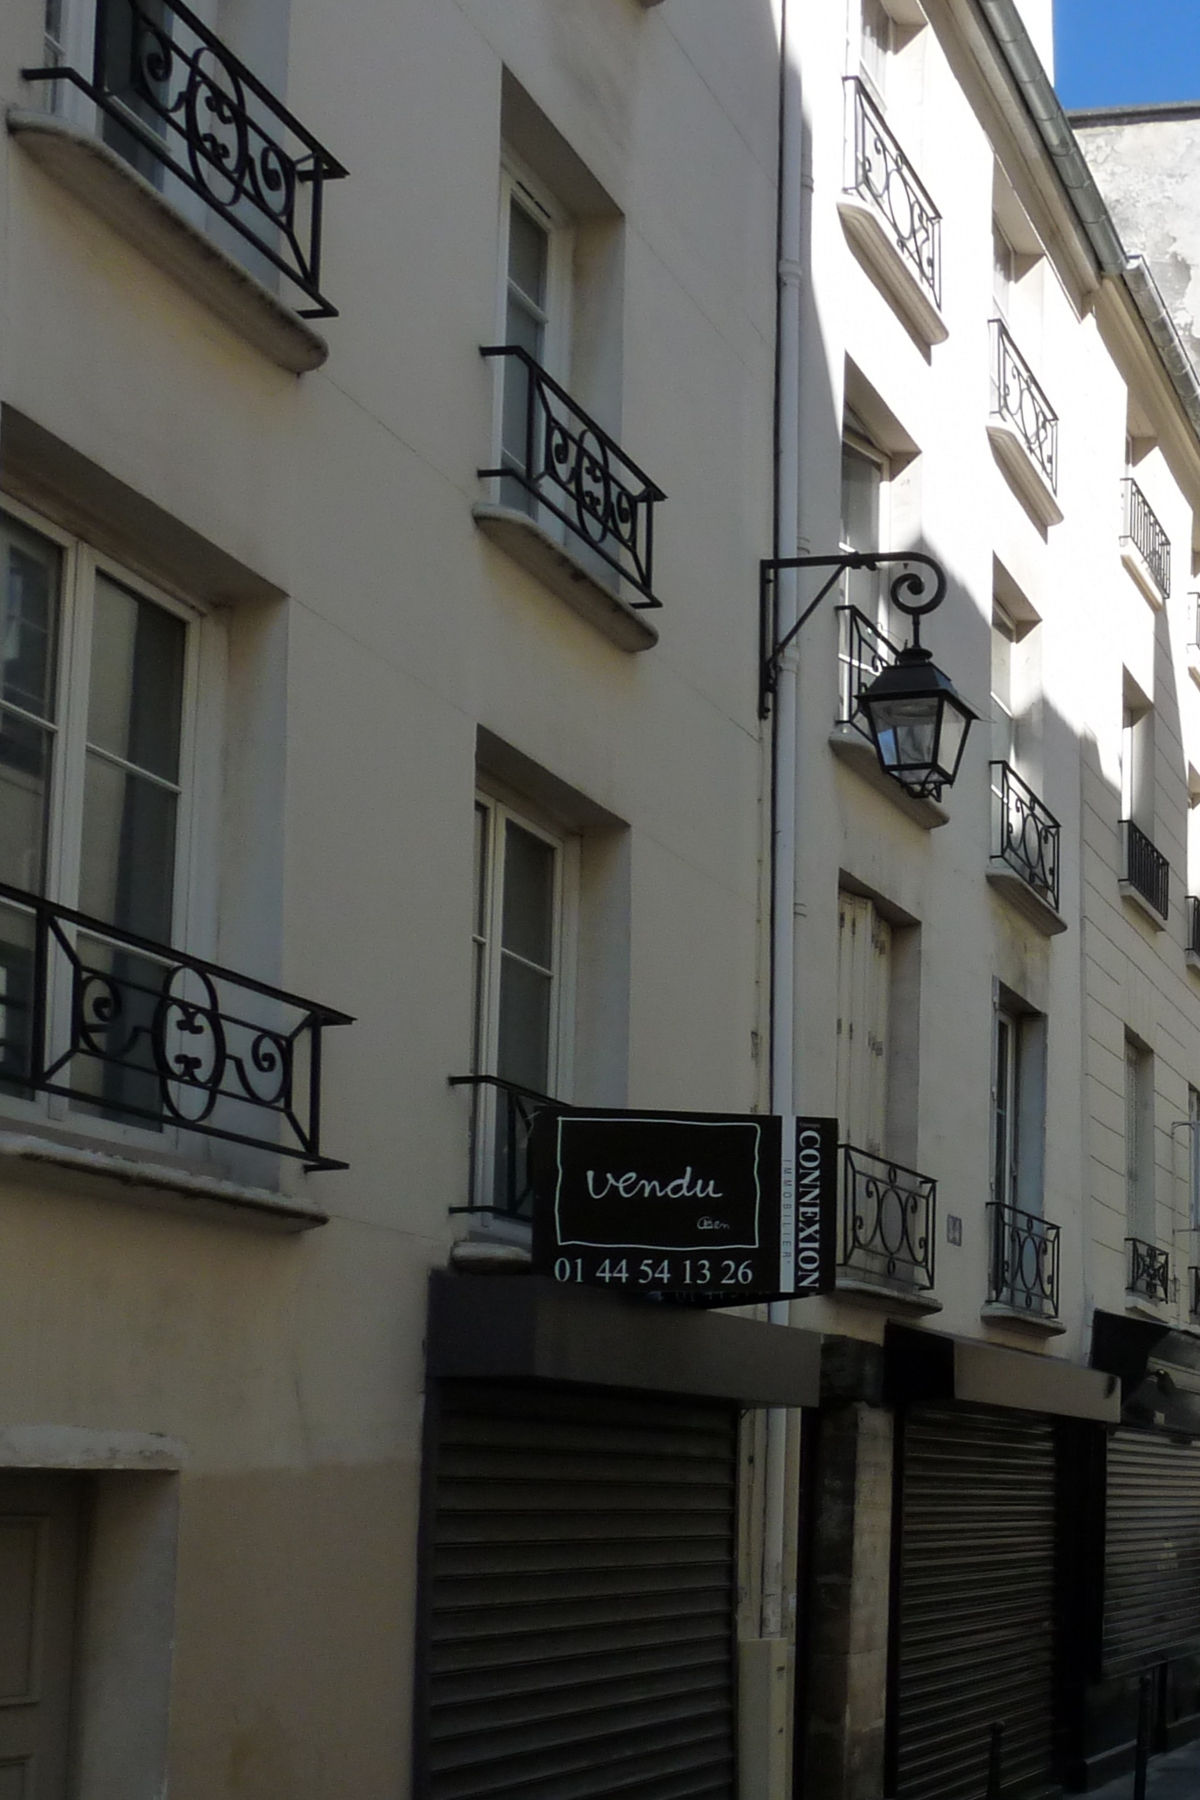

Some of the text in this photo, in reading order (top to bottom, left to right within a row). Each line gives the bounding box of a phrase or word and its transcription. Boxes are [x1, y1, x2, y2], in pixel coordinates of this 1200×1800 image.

[781, 1158, 792, 1260] IMMOBILIER
[798, 1129, 821, 1289] CONNEXION
[554, 1257, 753, 1285] 01 44 54 13 26
